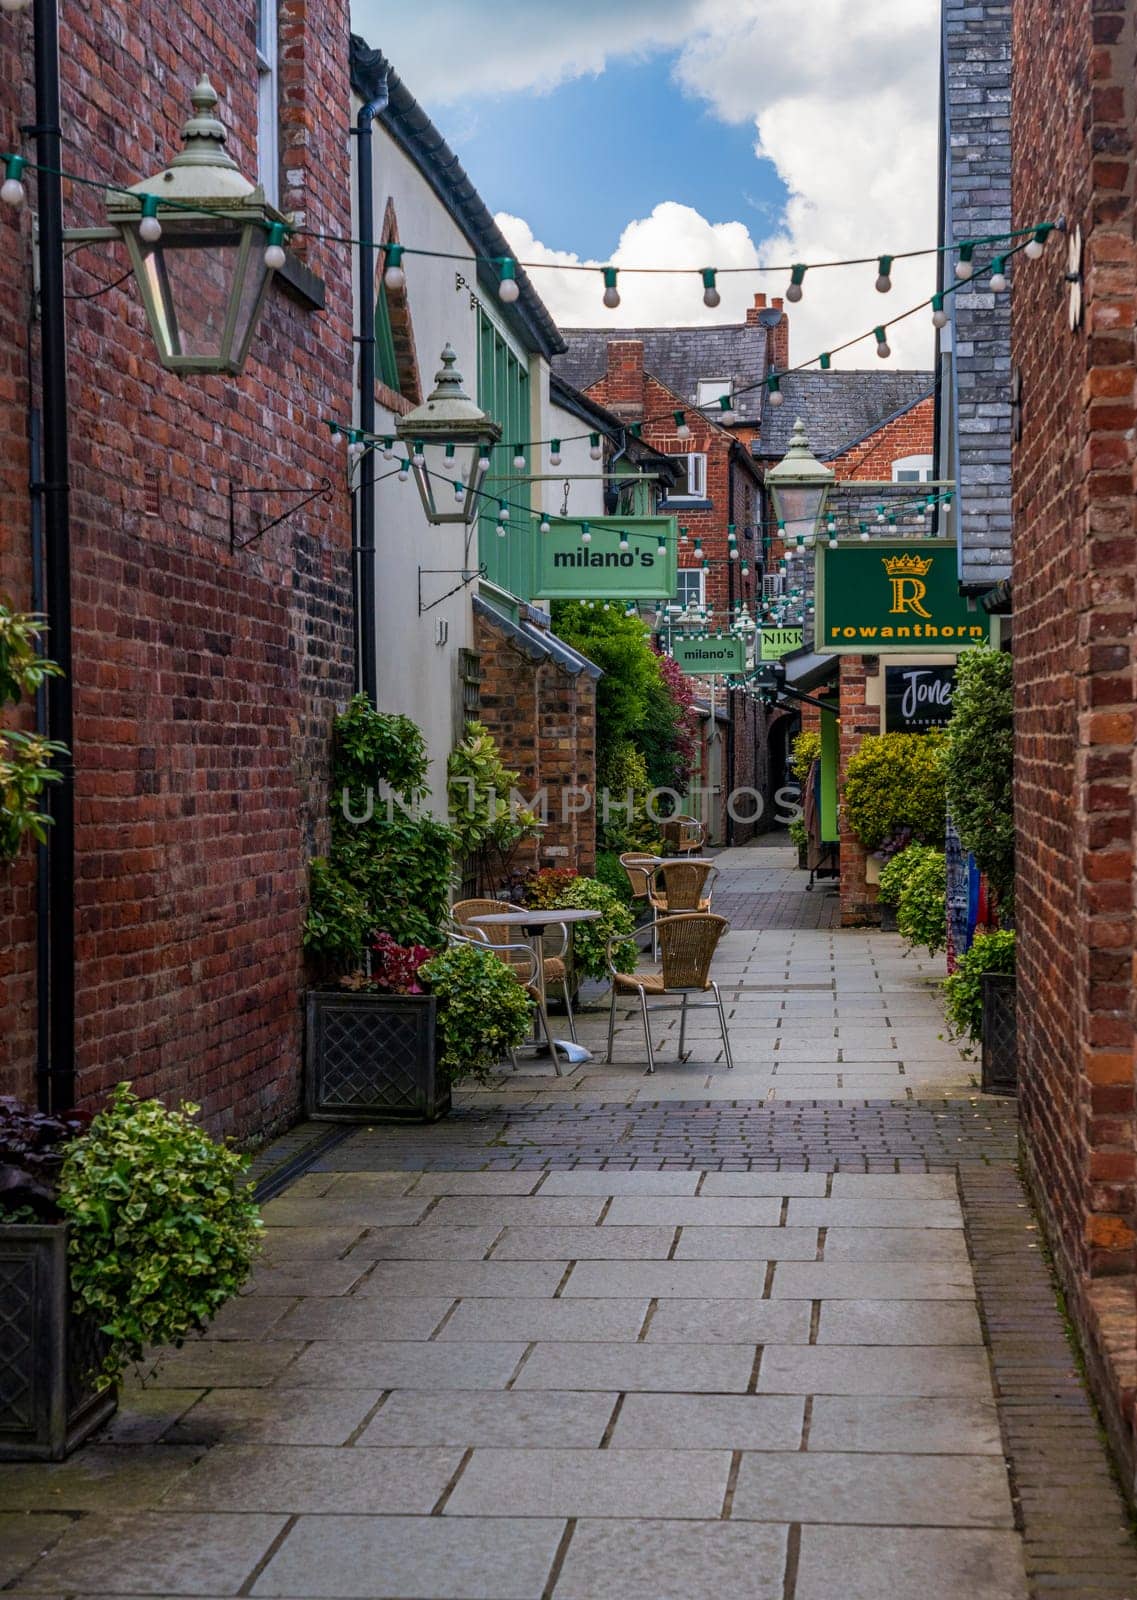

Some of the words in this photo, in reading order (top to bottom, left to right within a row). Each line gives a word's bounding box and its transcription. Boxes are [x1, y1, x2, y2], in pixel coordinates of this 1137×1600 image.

[553, 547, 654, 568] milano's
[889, 577, 933, 619] R
[831, 624, 983, 637] rowanthorn
[684, 648, 735, 659] milano's
